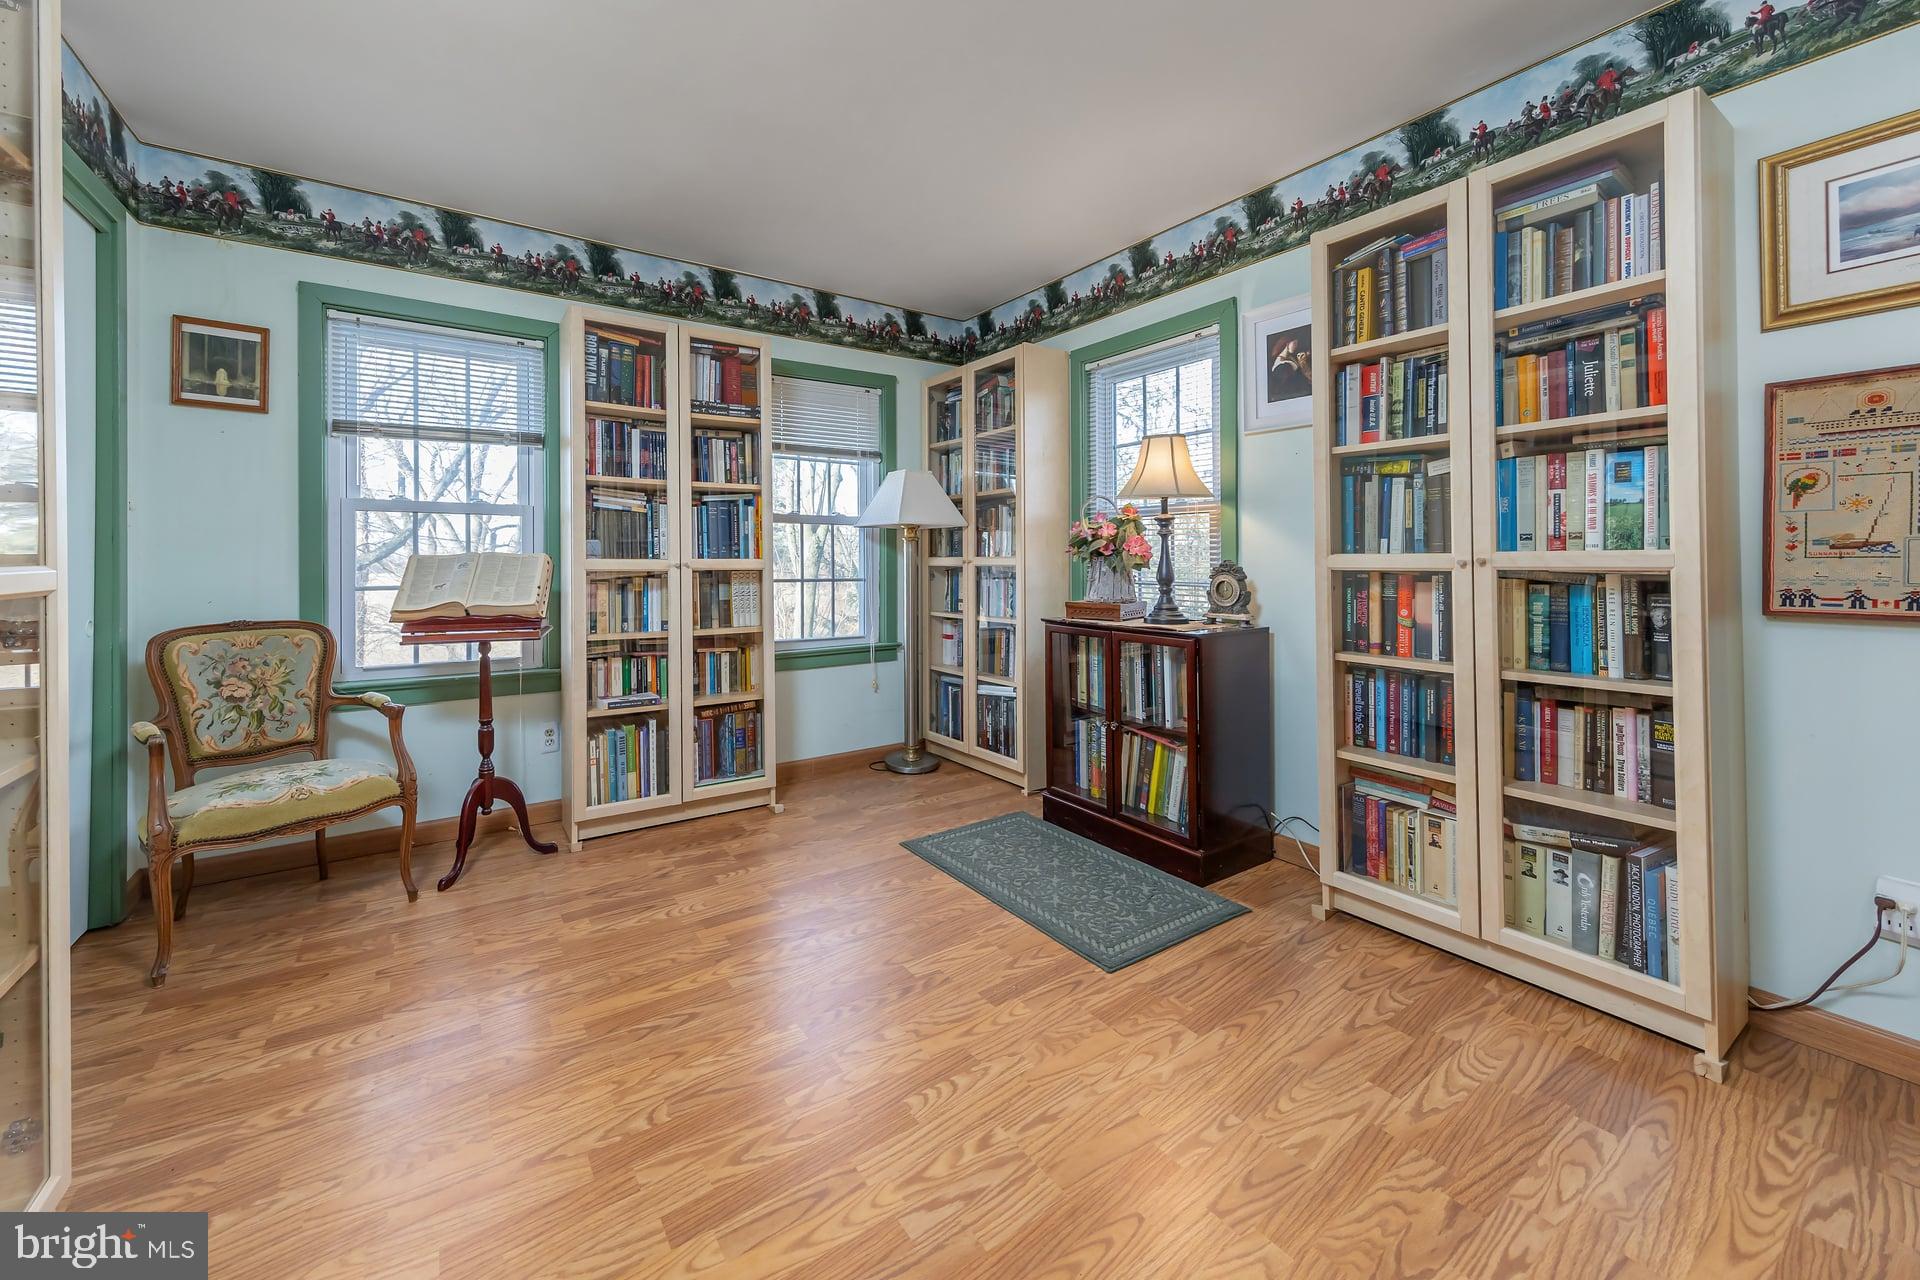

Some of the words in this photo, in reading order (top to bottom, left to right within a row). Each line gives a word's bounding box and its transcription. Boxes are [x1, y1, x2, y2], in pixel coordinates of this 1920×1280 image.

[1624, 199, 1632, 222] WORKING
[1624, 223, 1632, 236] WITH
[1624, 237, 1632, 261] DIFFICULT
[1358, 289, 1366, 311] CANTO
[1357, 312, 1365, 339] GENERAL
[585, 334, 597, 357] BOB
[585, 357, 597, 385] DYLAN
[1581, 359, 1599, 397] Juliette
[1647, 447, 1656, 479] UNIVERSITY
[1630, 577, 1638, 604] AGAINST
[1630, 606, 1639, 616] ALL
[1631, 618, 1639, 635] HOPE
[1354, 680, 1364, 704] Farewell
[1355, 711, 1364, 722] the
[1355, 723, 1364, 735] Sea
[1616, 758, 1625, 772] Three
[1631, 863, 1641, 880] JACK
[1579, 897, 1592, 932] Yesterday
[1632, 912, 1642, 967] PHOTOGRAPHER
